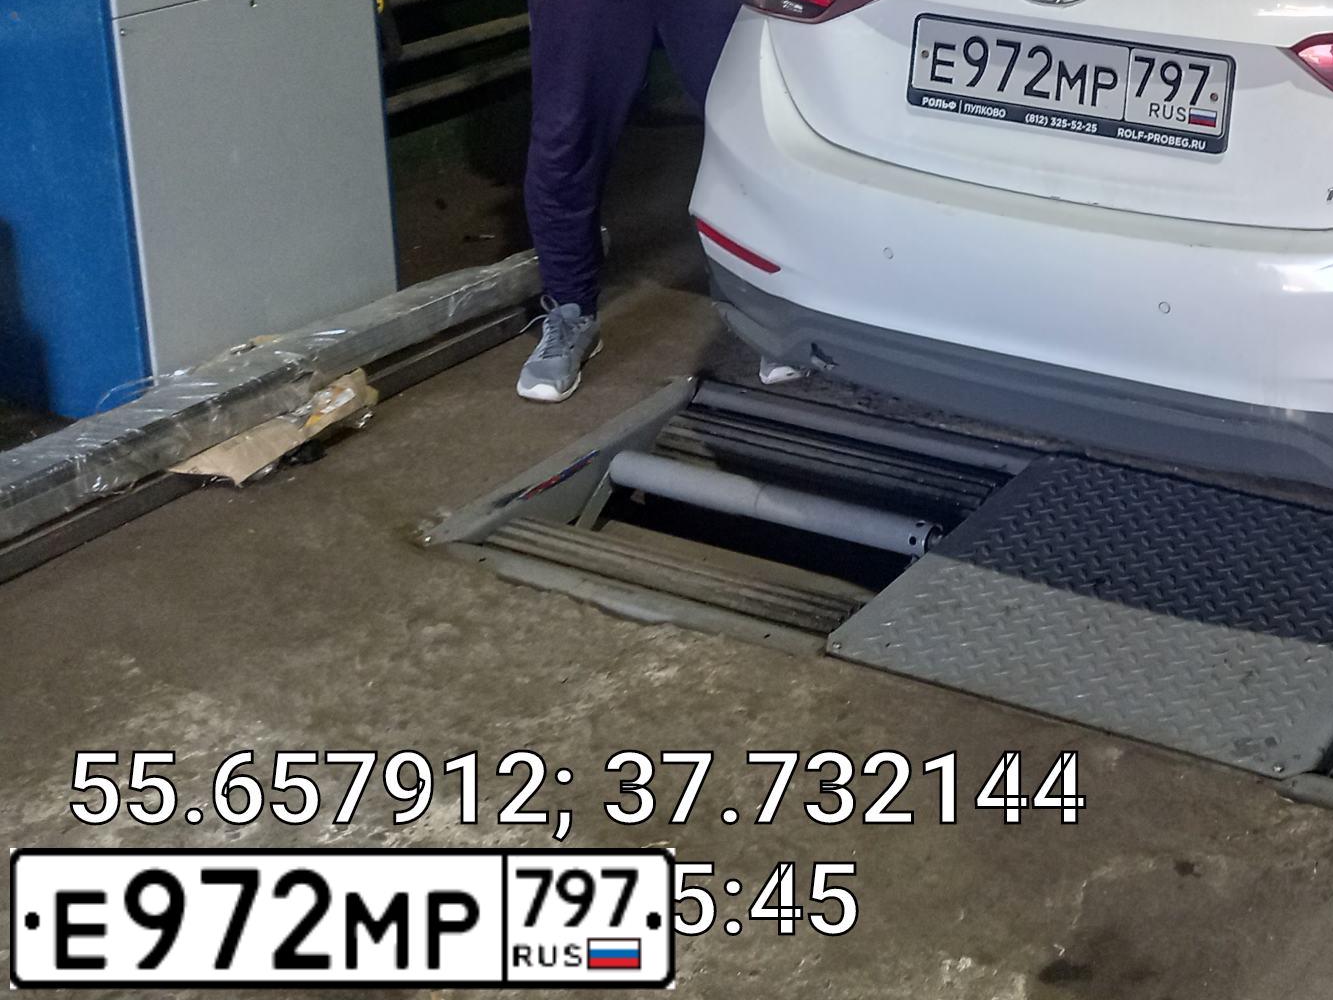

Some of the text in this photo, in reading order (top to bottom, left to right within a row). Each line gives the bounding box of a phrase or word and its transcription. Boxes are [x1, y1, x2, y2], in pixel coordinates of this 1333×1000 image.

[930, 35, 1119, 108] Е972МР
[1134, 55, 1211, 106] 797
[921, 96, 1206, 151] РОЛЬФ ПУЛКОВО (812) 325-52-25 ROLF-PROBEG.RU
[1148, 102, 1187, 123] RUS
